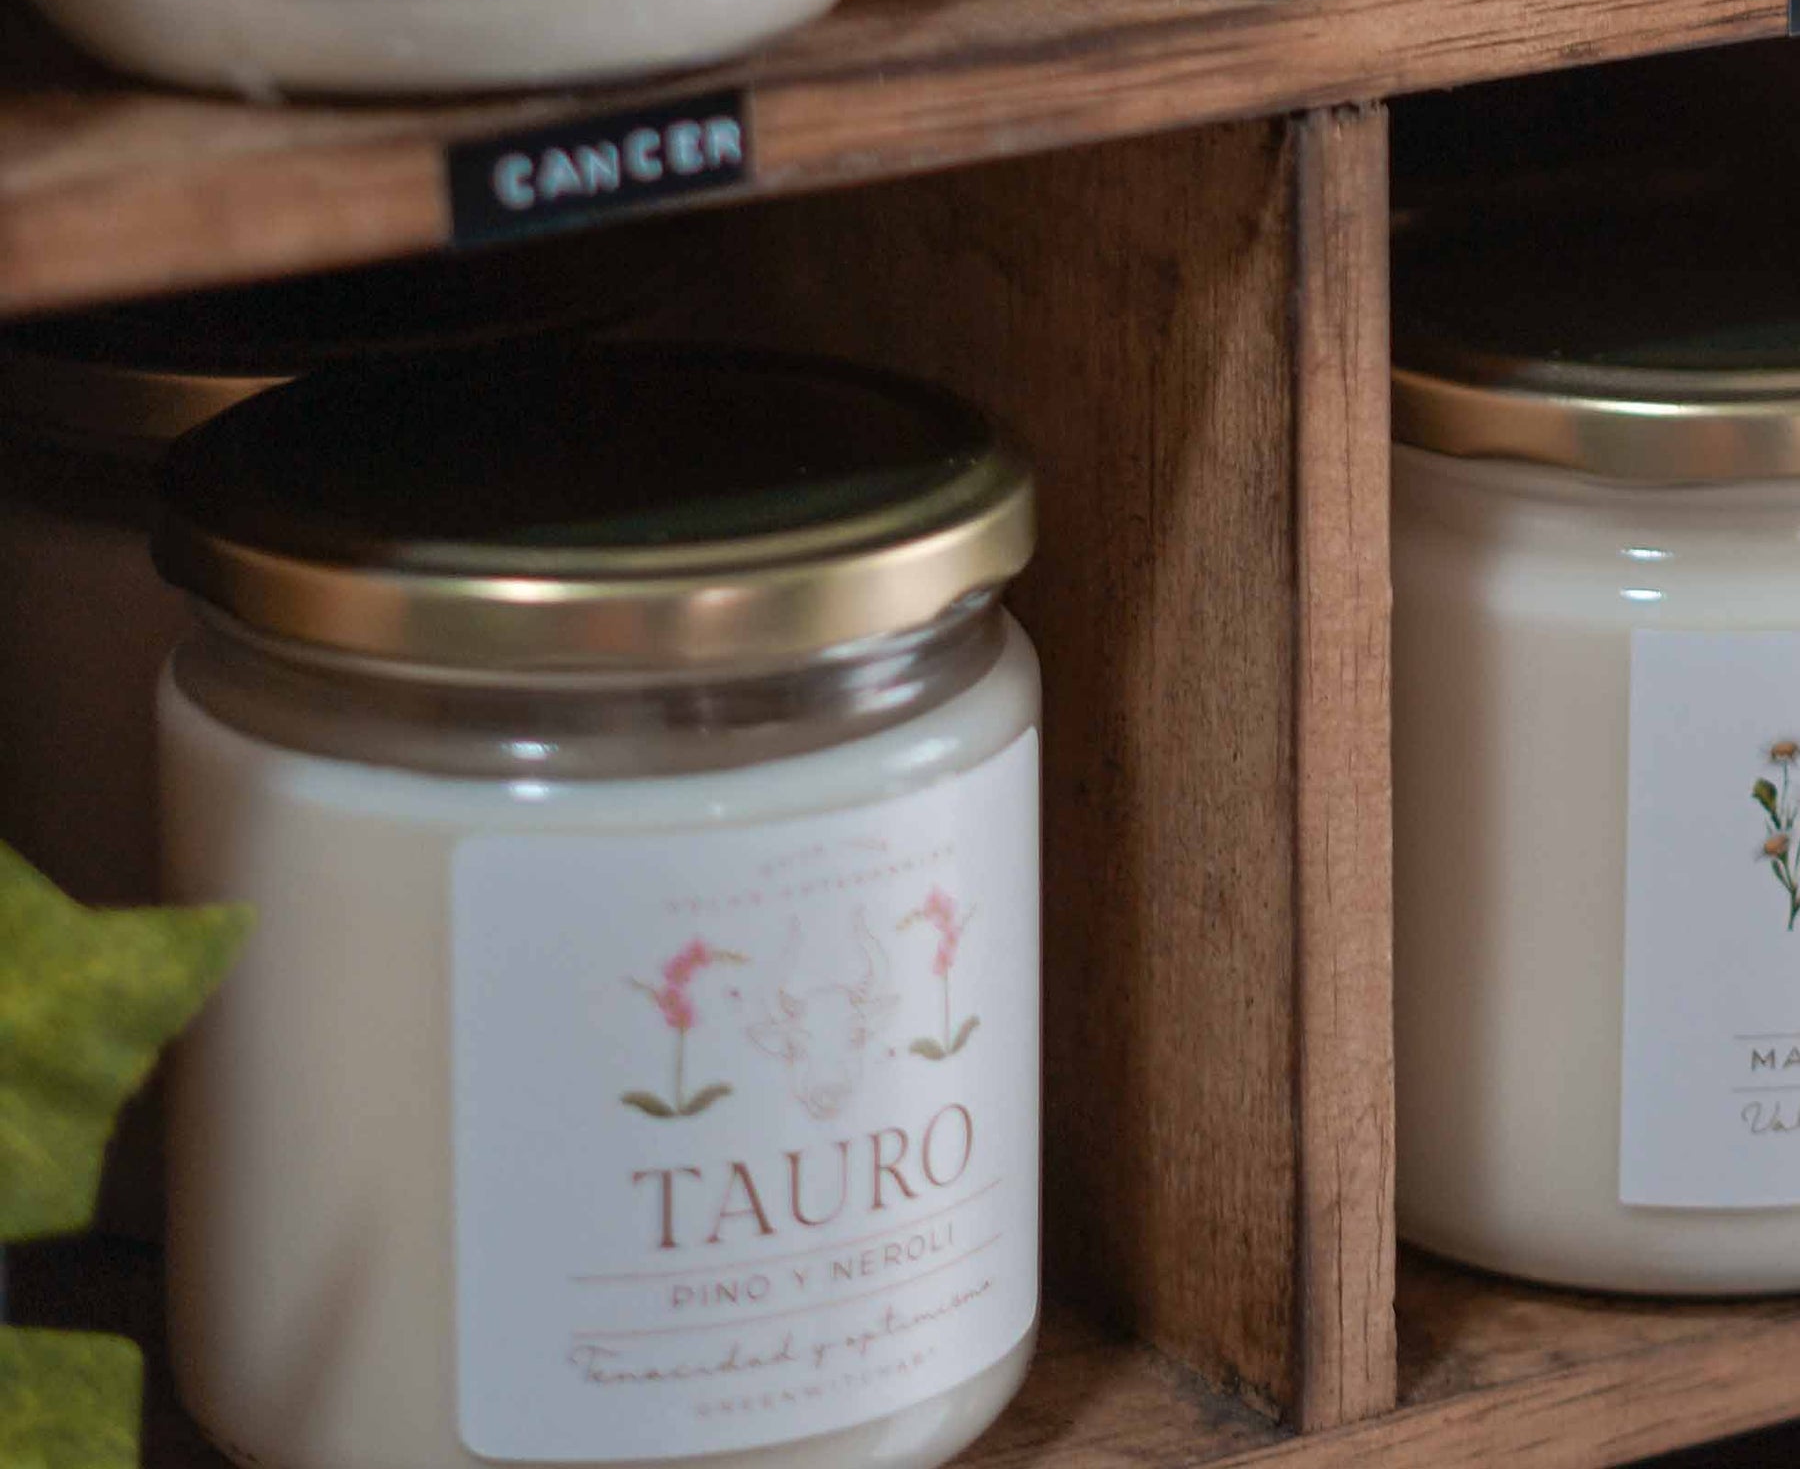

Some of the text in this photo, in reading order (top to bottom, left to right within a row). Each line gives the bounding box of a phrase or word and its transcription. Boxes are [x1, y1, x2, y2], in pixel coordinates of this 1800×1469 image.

[492, 115, 743, 210] CANCER
[630, 1102, 976, 1251] TAURO
[670, 1221, 955, 1310] PINO Y NEROLI
